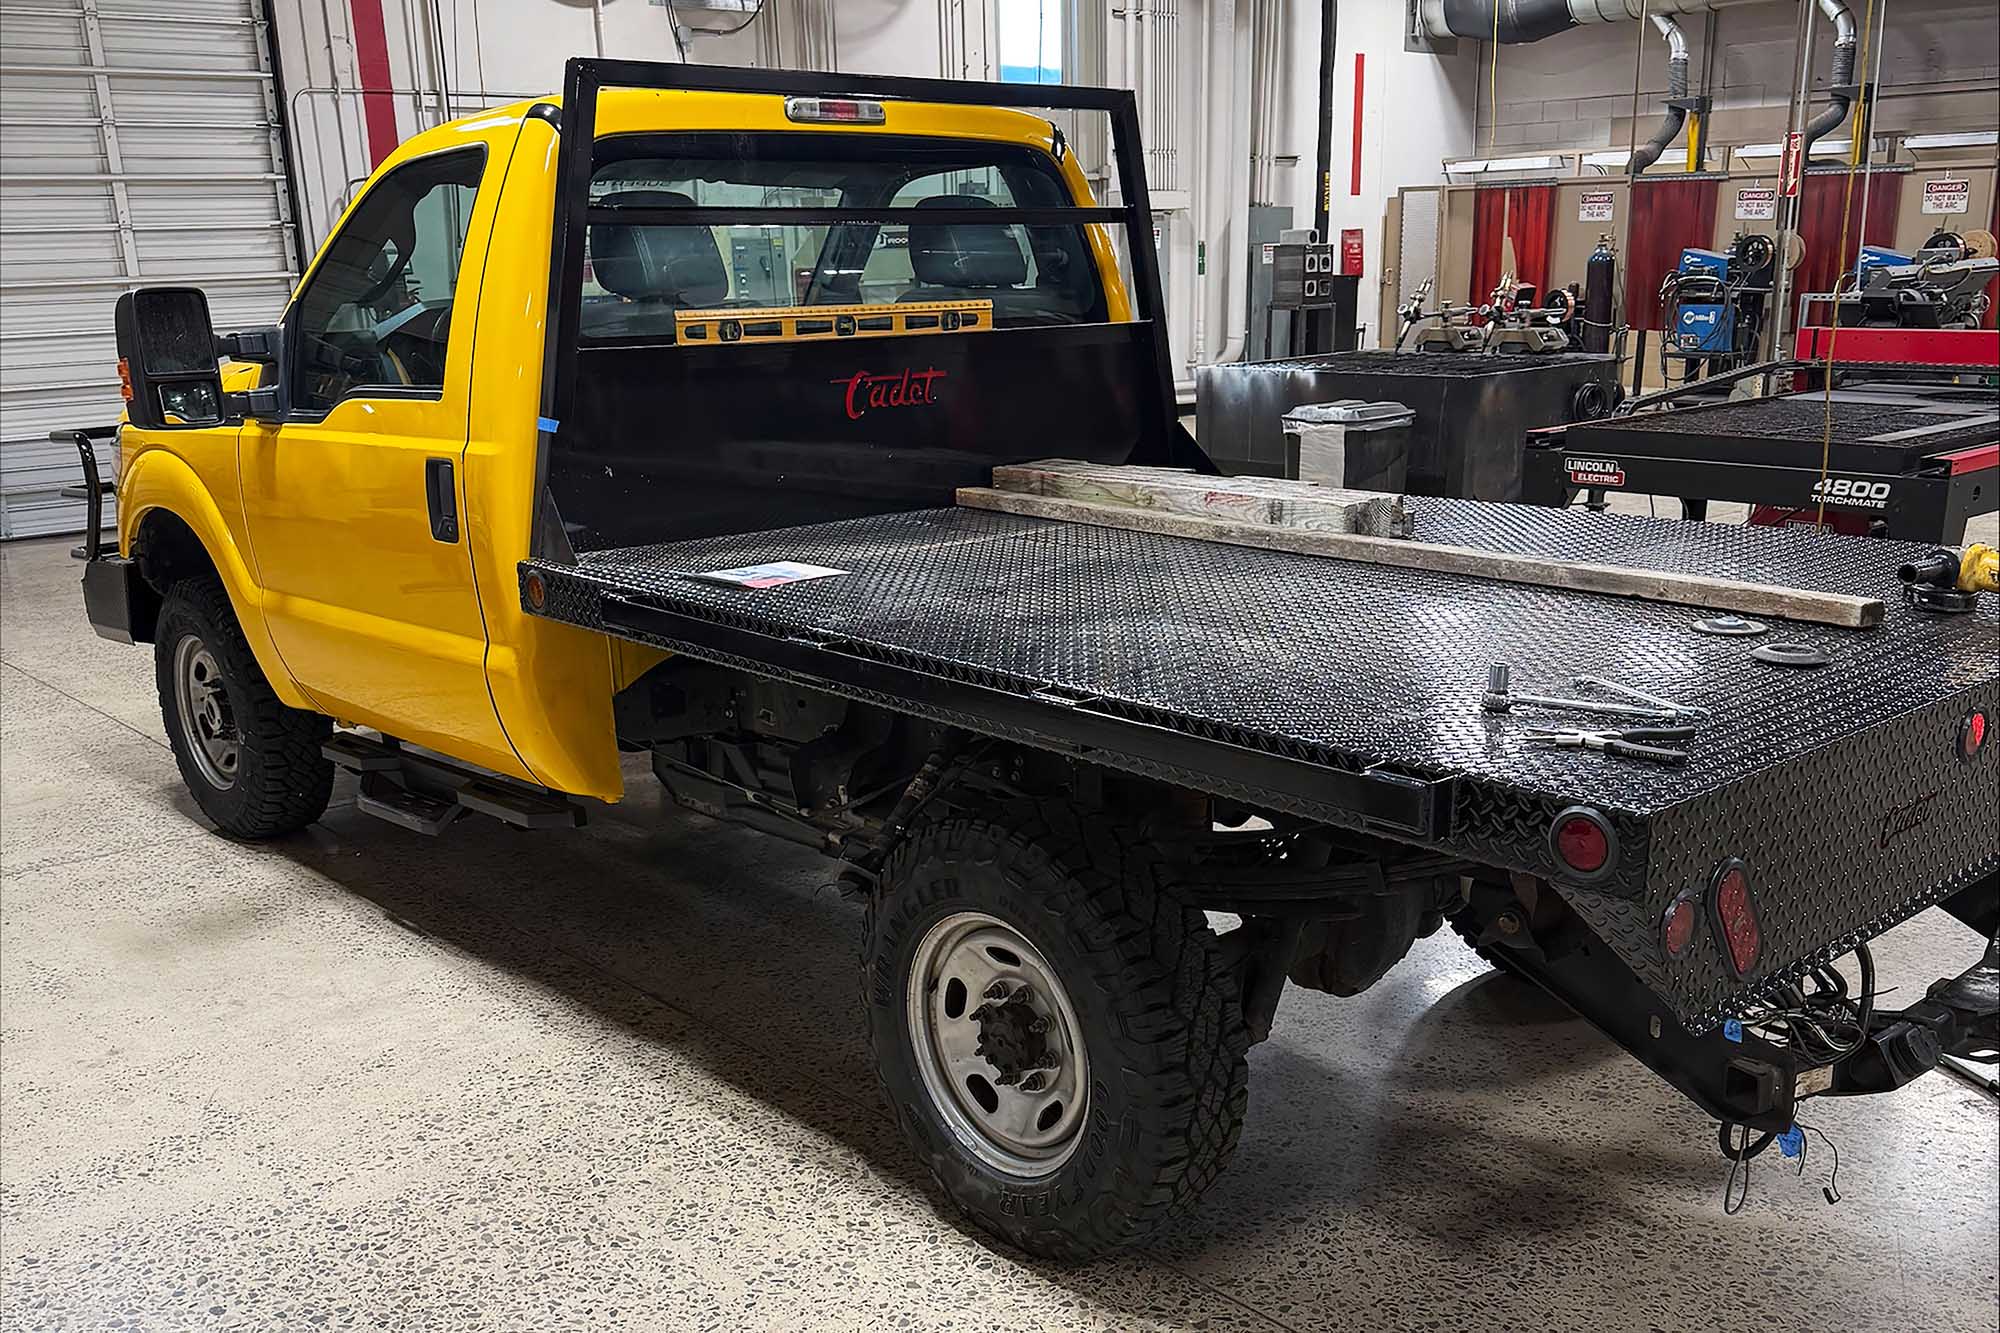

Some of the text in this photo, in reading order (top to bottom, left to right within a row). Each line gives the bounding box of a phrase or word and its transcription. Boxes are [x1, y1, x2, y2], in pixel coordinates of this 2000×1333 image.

[1743, 191, 1770, 199] DANGER
[1567, 460, 1615, 473] LINCOLN
[1577, 472, 1620, 484] ELECTRIC
[1813, 478, 1891, 500] 4800
[1810, 494, 1888, 509] TORCHMATE
[1786, 521, 1832, 534] LINCON
